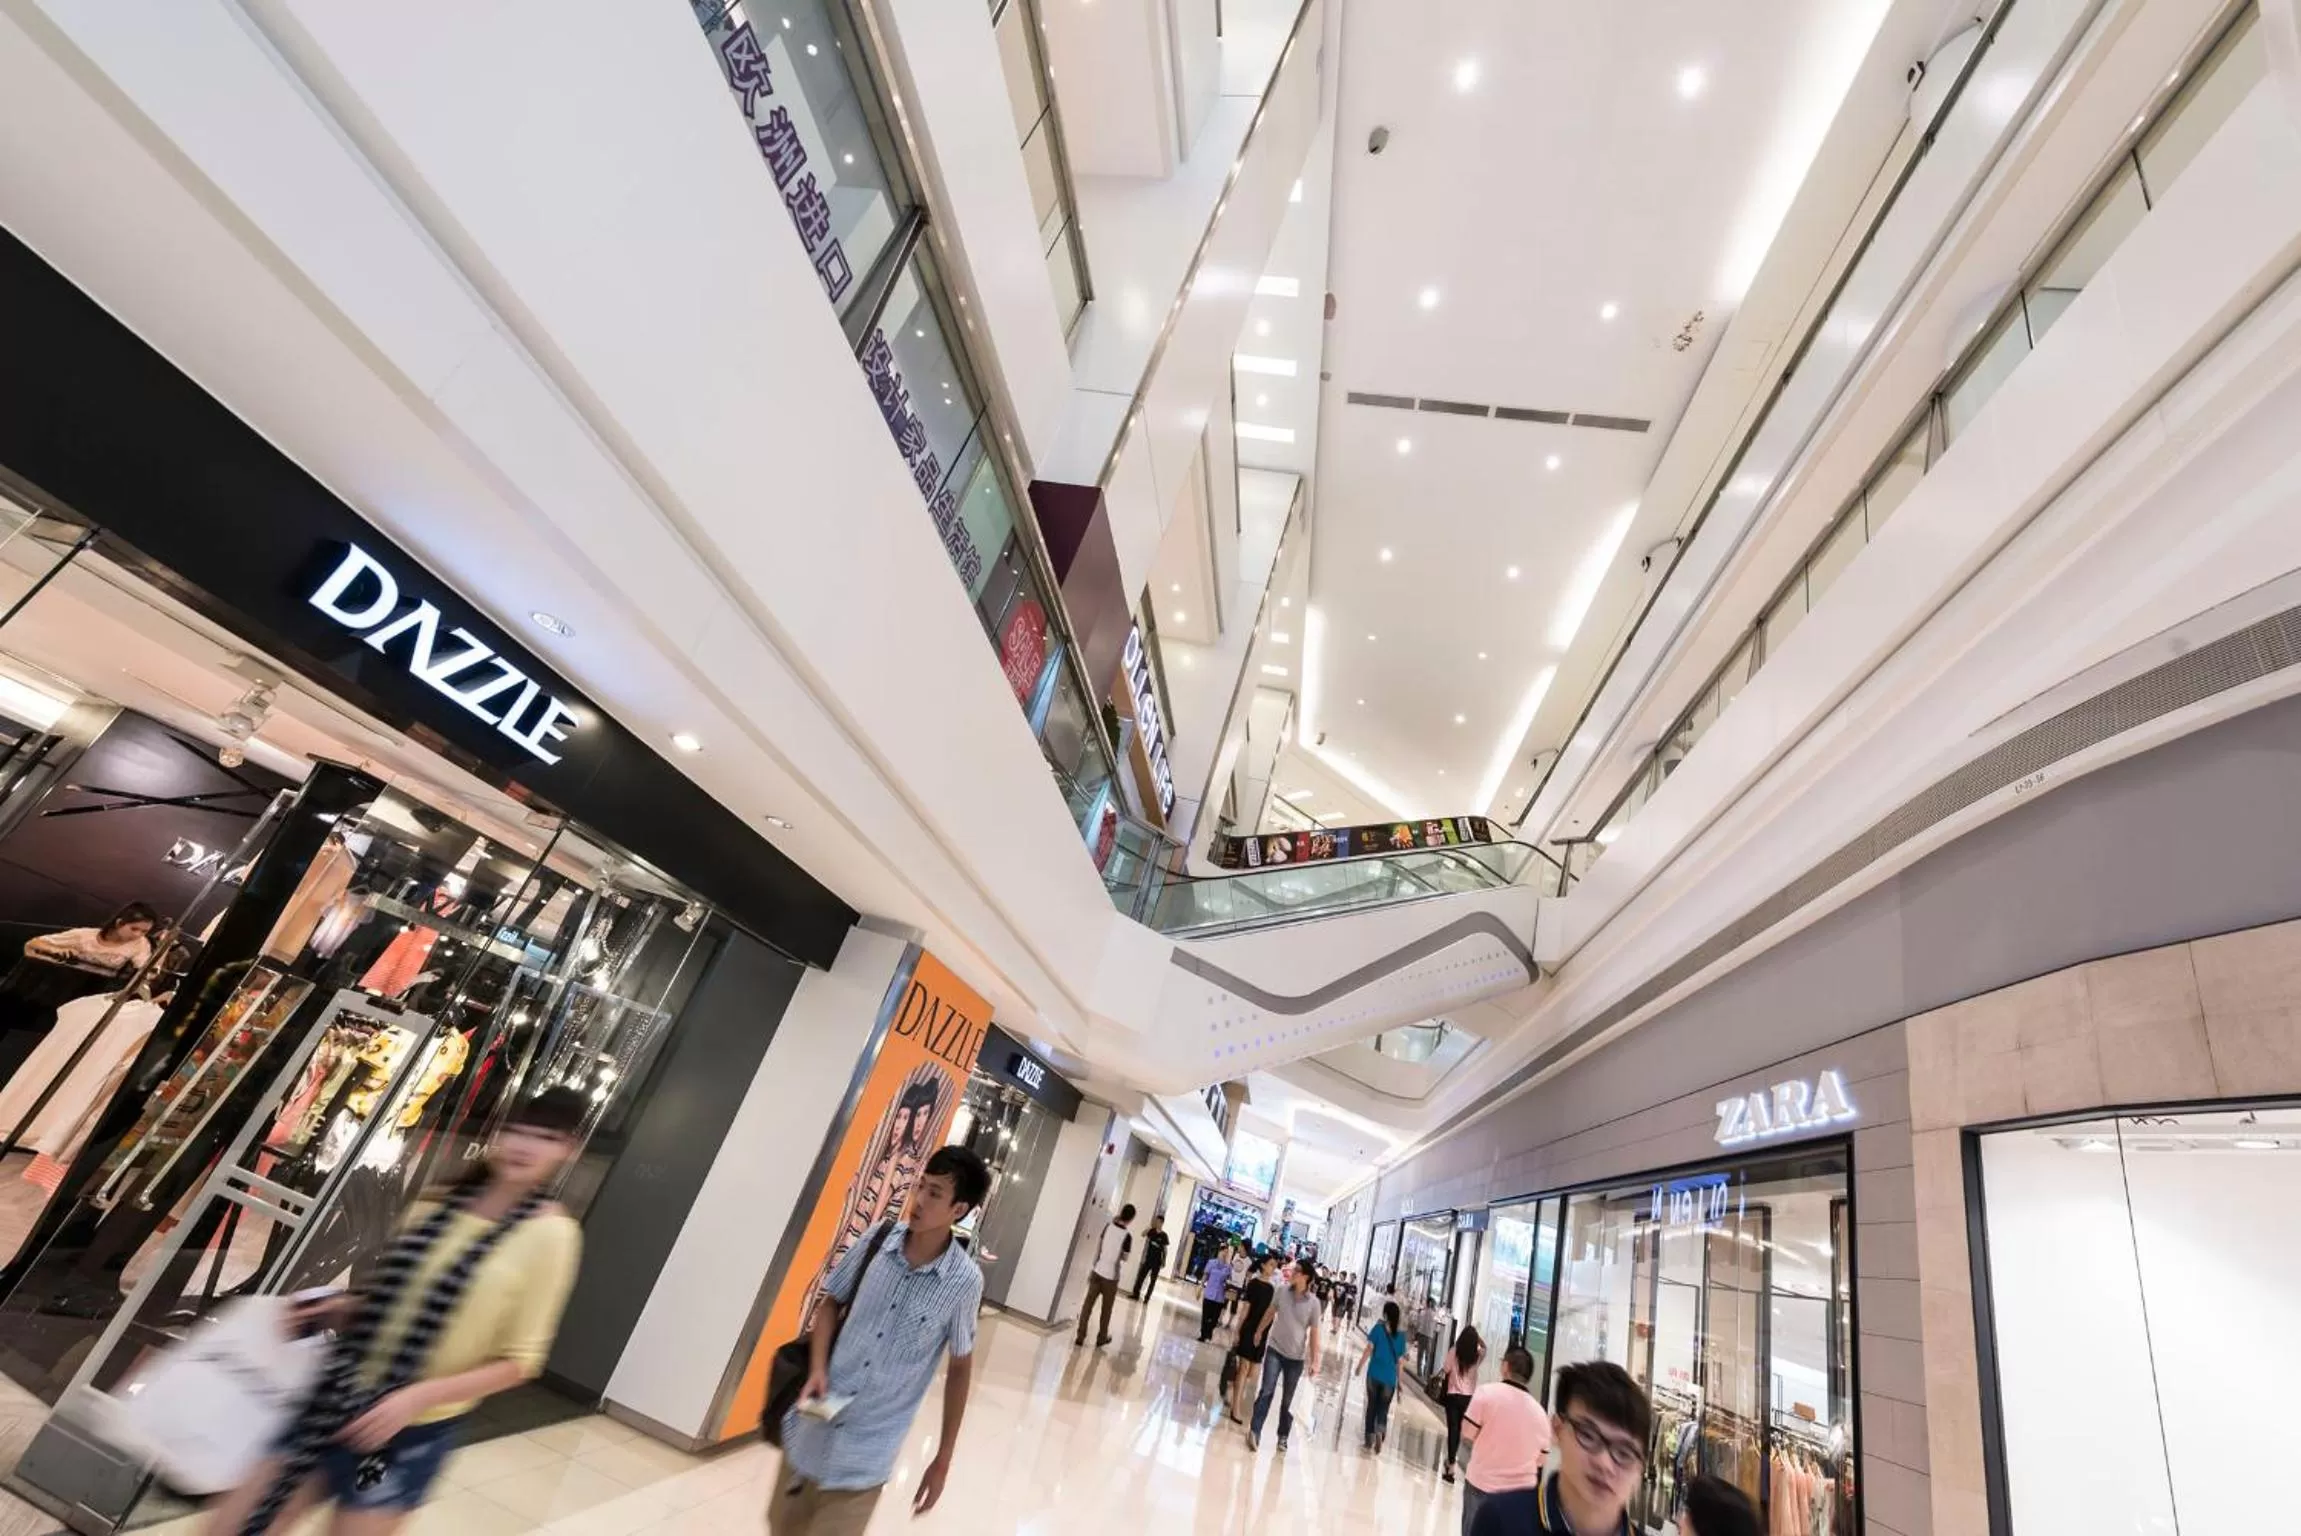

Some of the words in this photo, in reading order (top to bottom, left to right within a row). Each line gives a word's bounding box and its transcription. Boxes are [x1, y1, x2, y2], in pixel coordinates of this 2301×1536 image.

[721, 20, 853, 303] 欧洲进口
[308, 541, 579, 766] DAZZLE
[895, 980, 985, 1074] DAZZLE
[1713, 1070, 1856, 1146] ZARA
